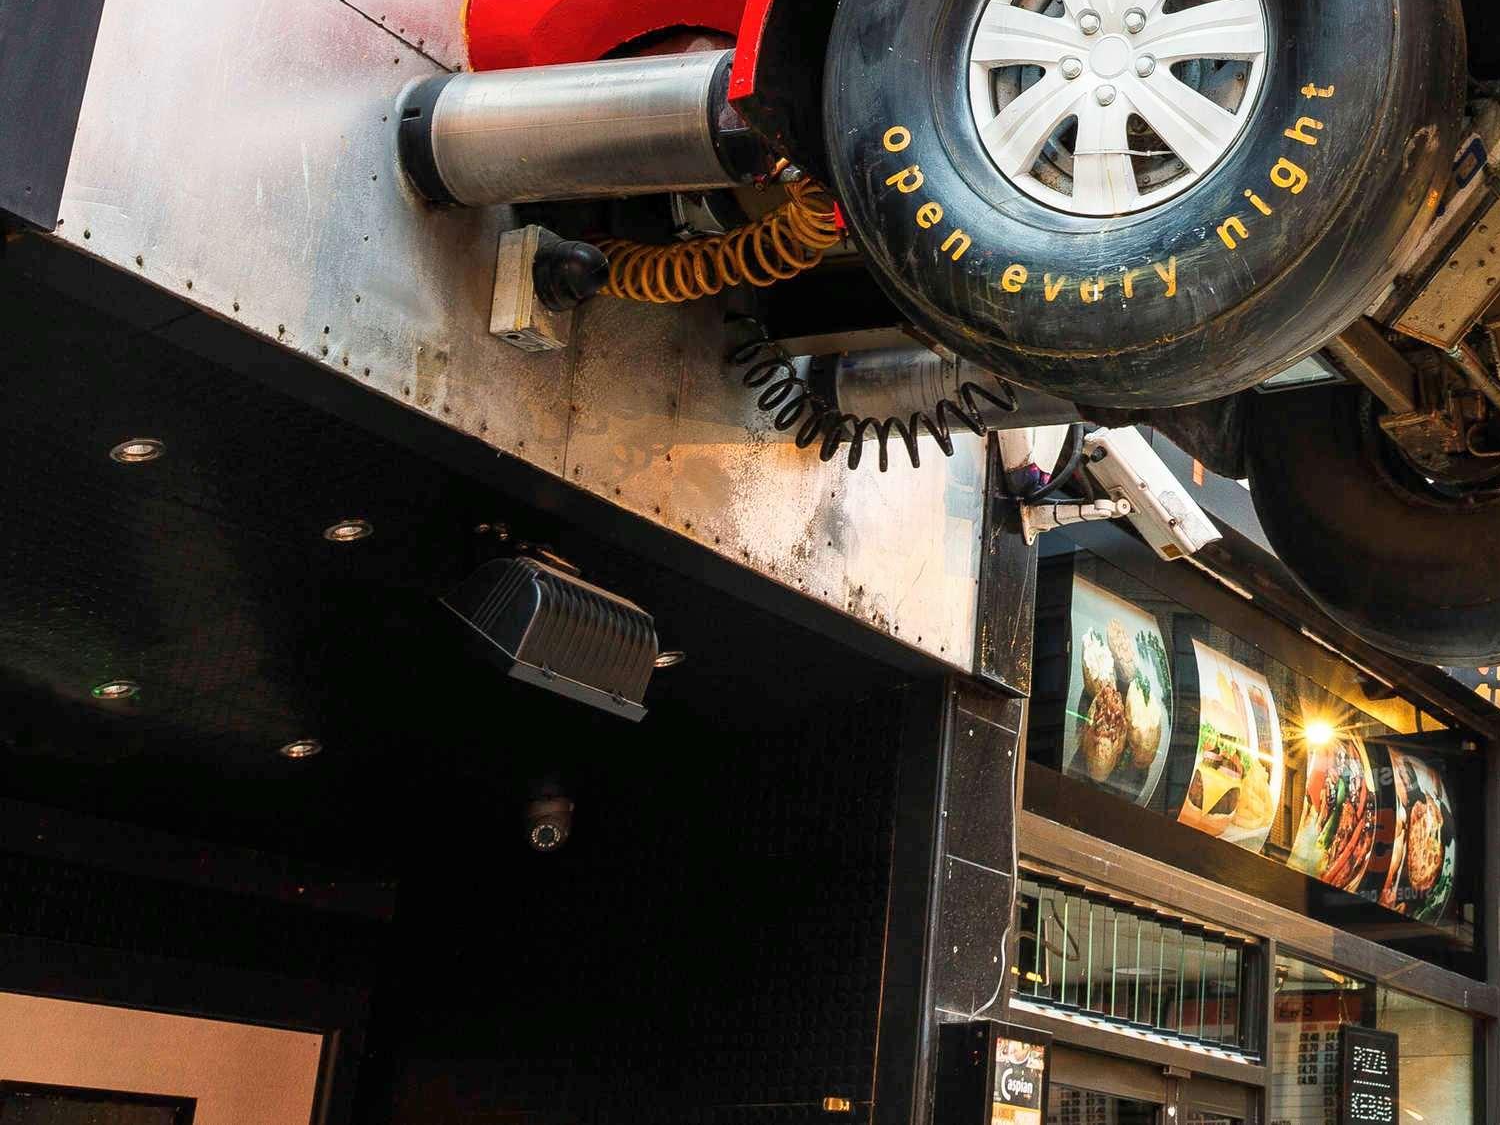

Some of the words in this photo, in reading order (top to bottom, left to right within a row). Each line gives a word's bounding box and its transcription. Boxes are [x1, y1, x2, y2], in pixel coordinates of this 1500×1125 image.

[883, 125, 973, 261] open
[1001, 255, 1178, 304] every
[1215, 81, 1336, 250] night
[1353, 1046, 1389, 1075] PIZZA
[1001, 1067, 1034, 1101] Caspian
[1351, 1092, 1392, 1122] KEBAB
